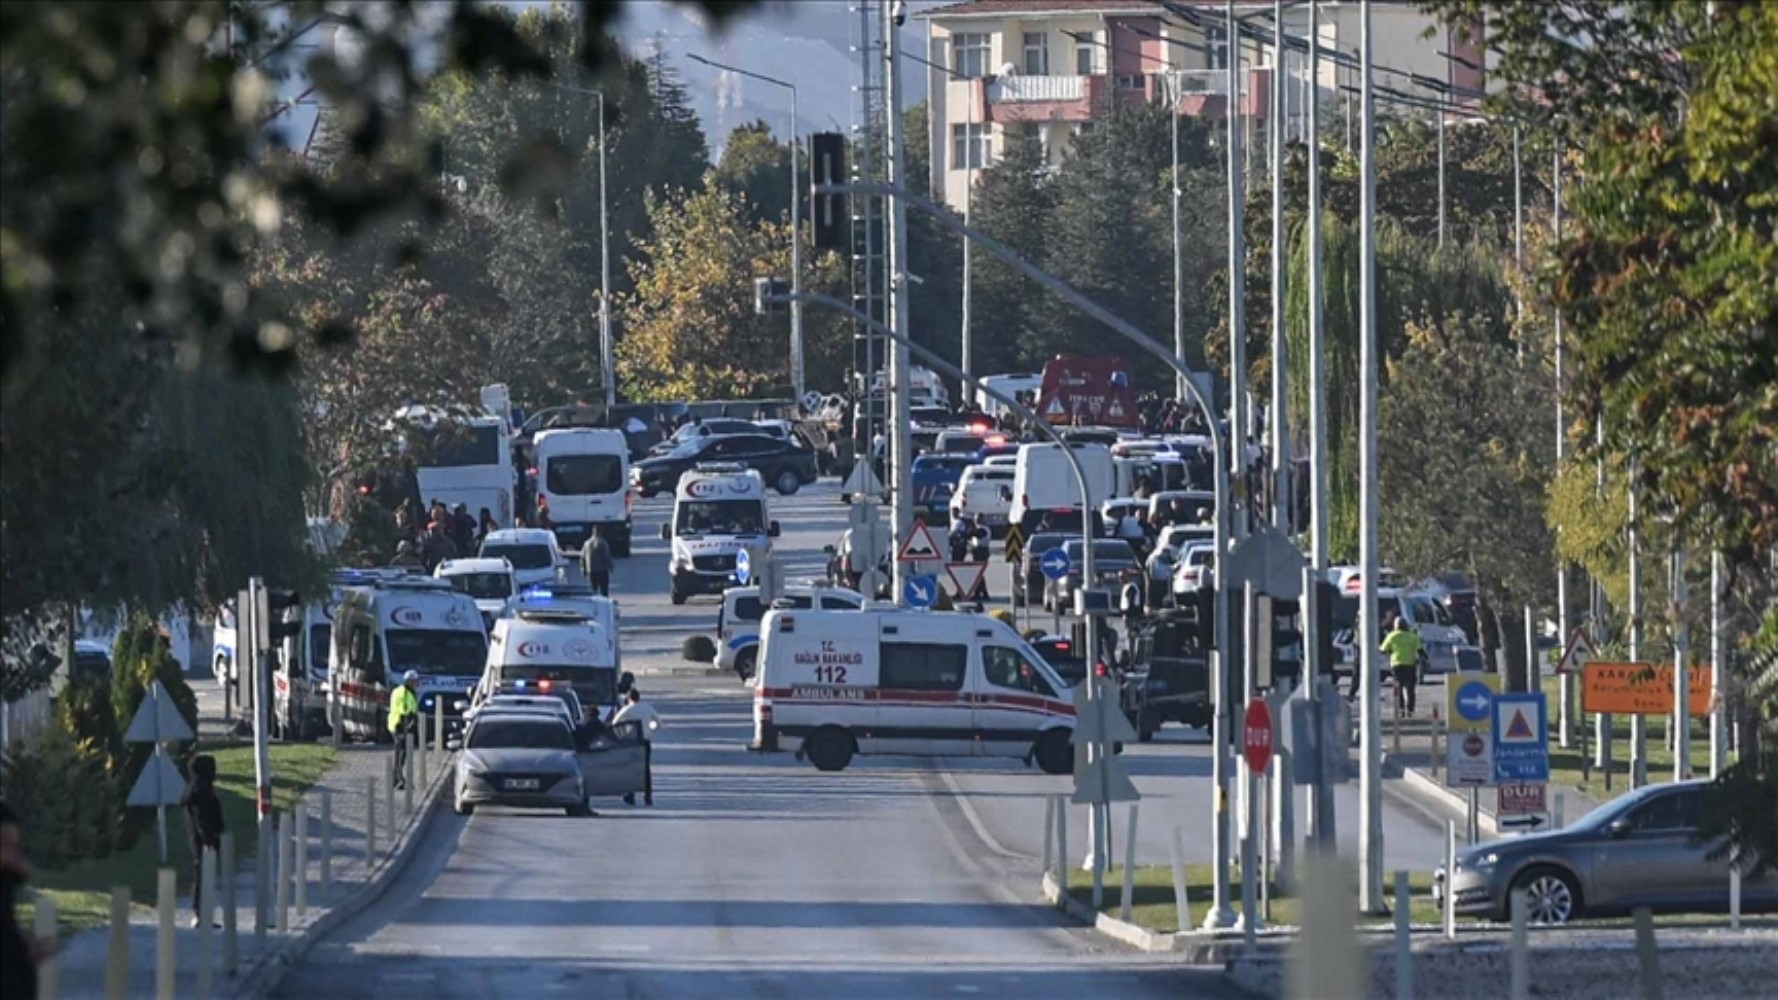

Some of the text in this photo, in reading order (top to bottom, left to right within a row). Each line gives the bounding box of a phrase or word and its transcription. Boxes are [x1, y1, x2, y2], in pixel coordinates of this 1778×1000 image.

[814, 666, 847, 683] 112
[792, 687, 864, 700] AMBULANS
[1246, 726, 1270, 747] DUR
[1502, 786, 1540, 797] DUR
